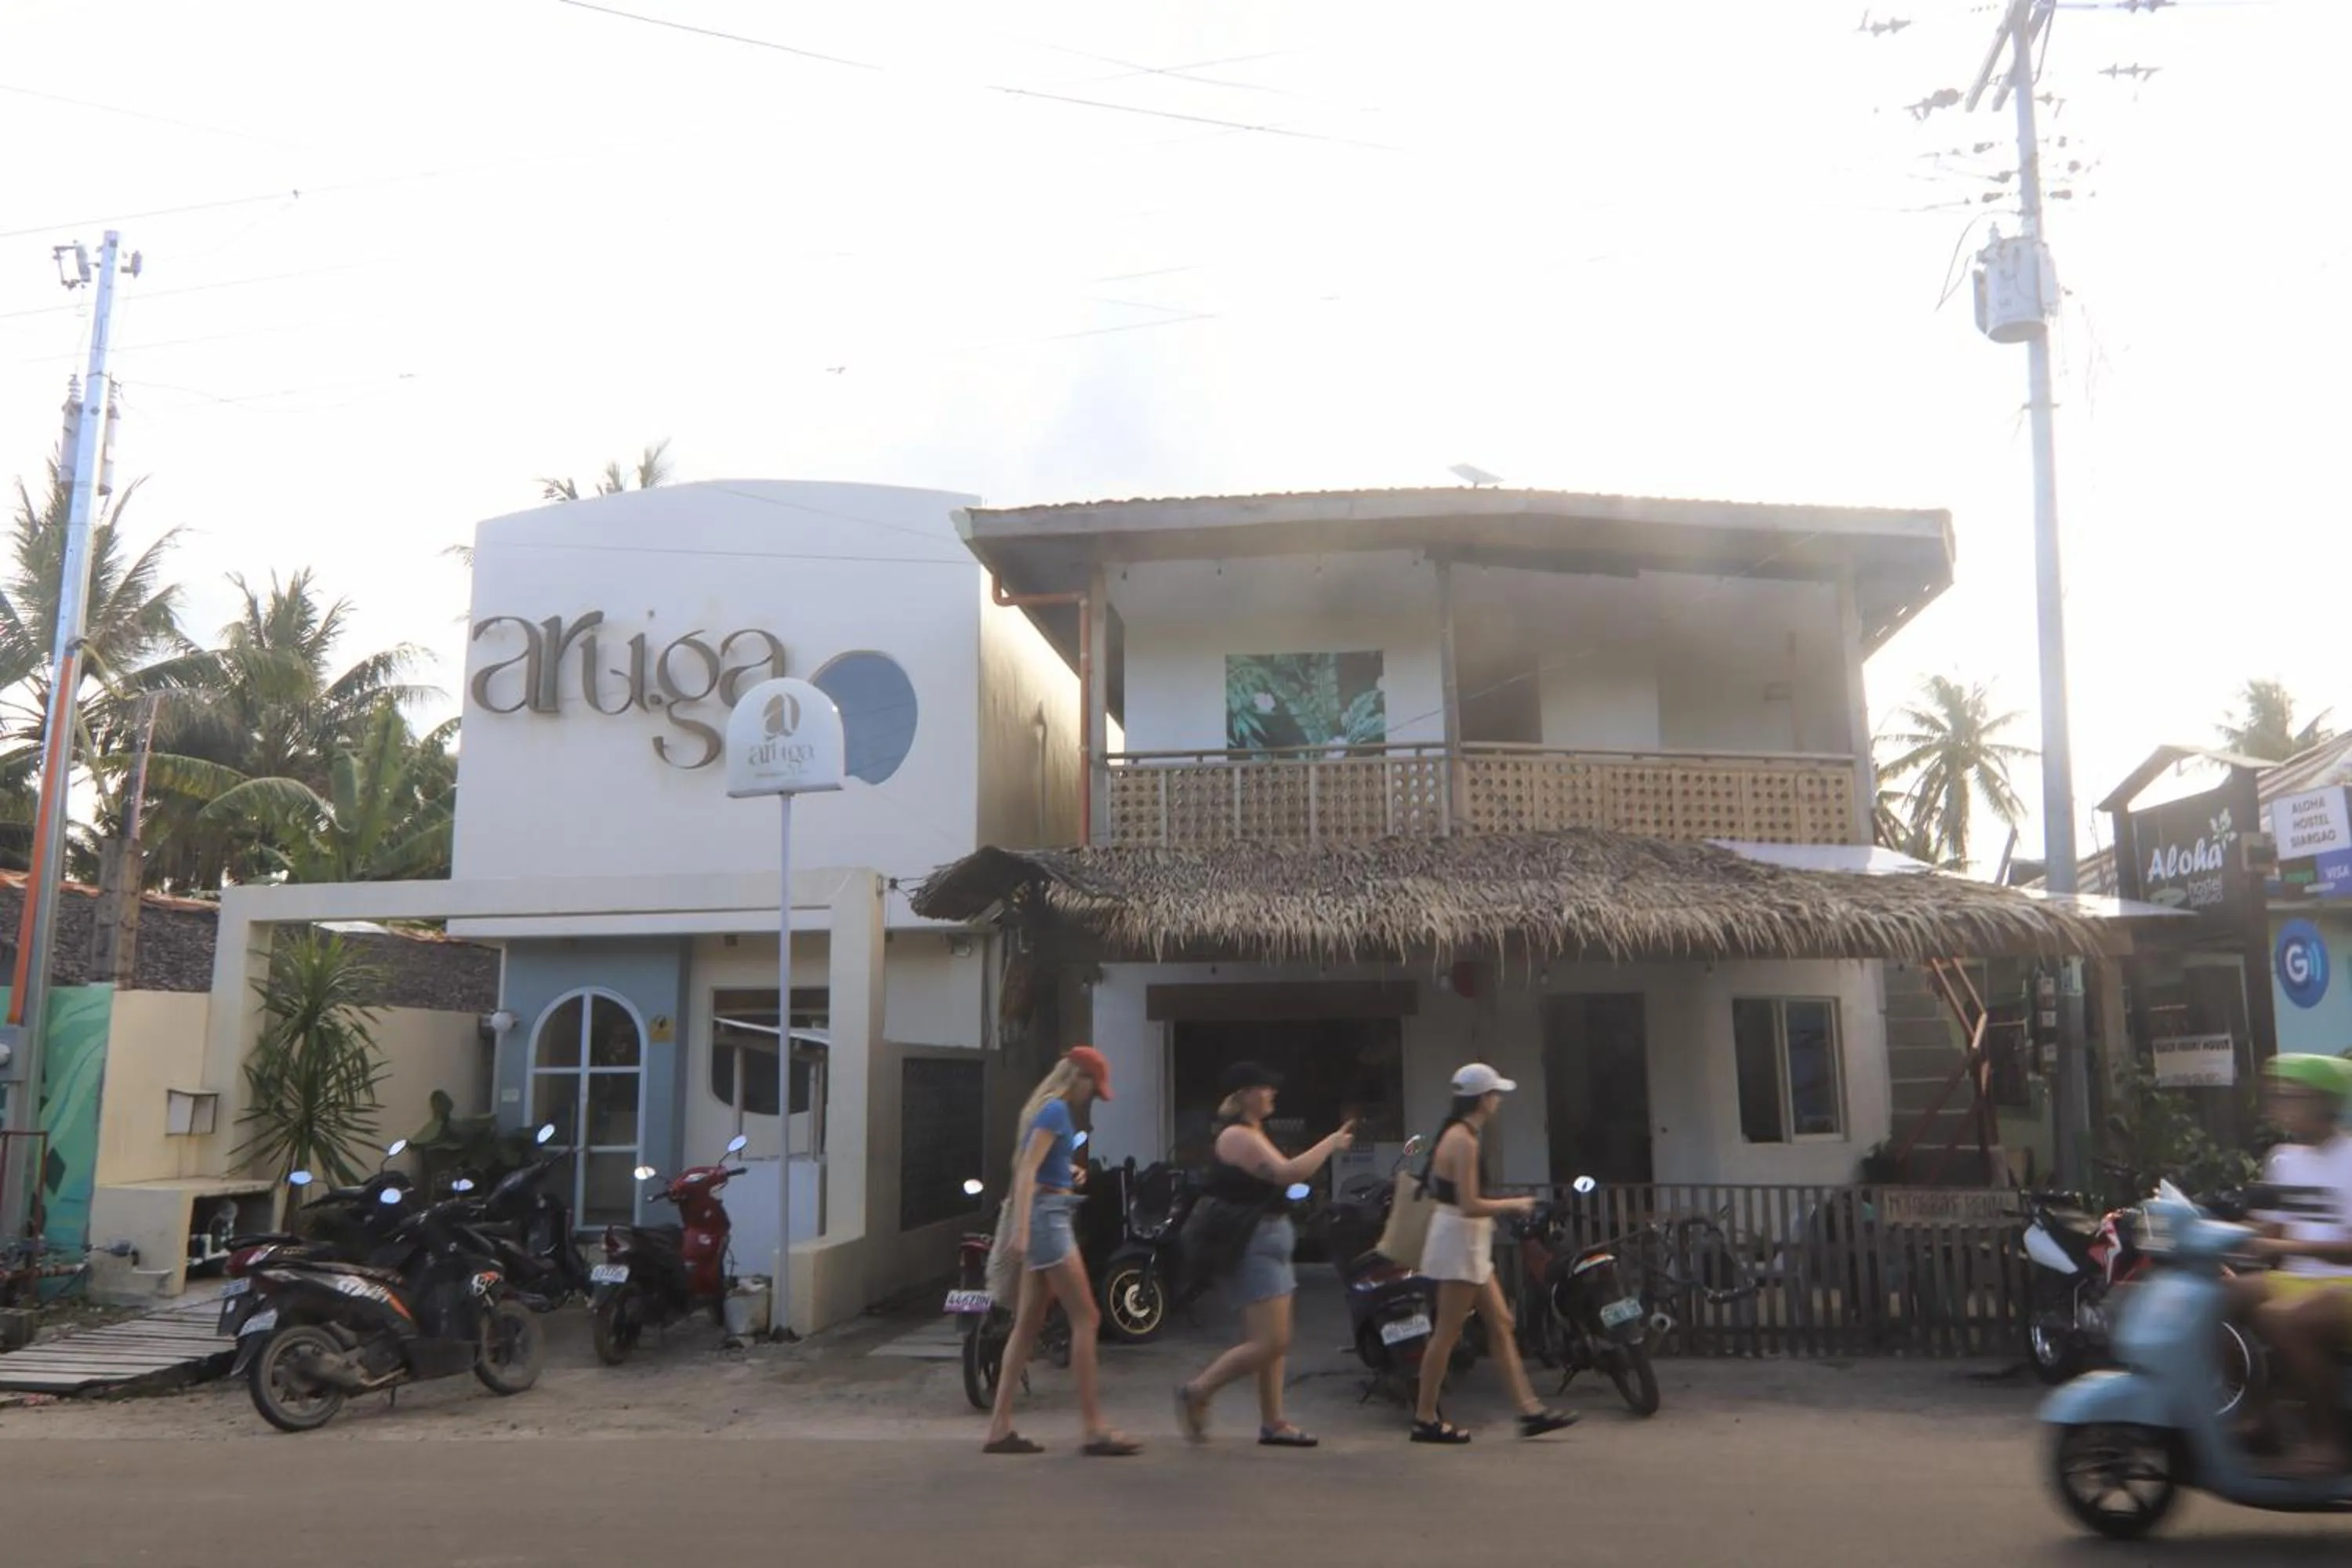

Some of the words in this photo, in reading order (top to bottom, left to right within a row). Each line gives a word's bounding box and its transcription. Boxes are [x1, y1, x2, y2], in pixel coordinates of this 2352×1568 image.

[2292, 797, 2325, 814] ALOHA
[2293, 813, 2330, 831] HOSTEL
[2147, 837, 2223, 884] Aloha
